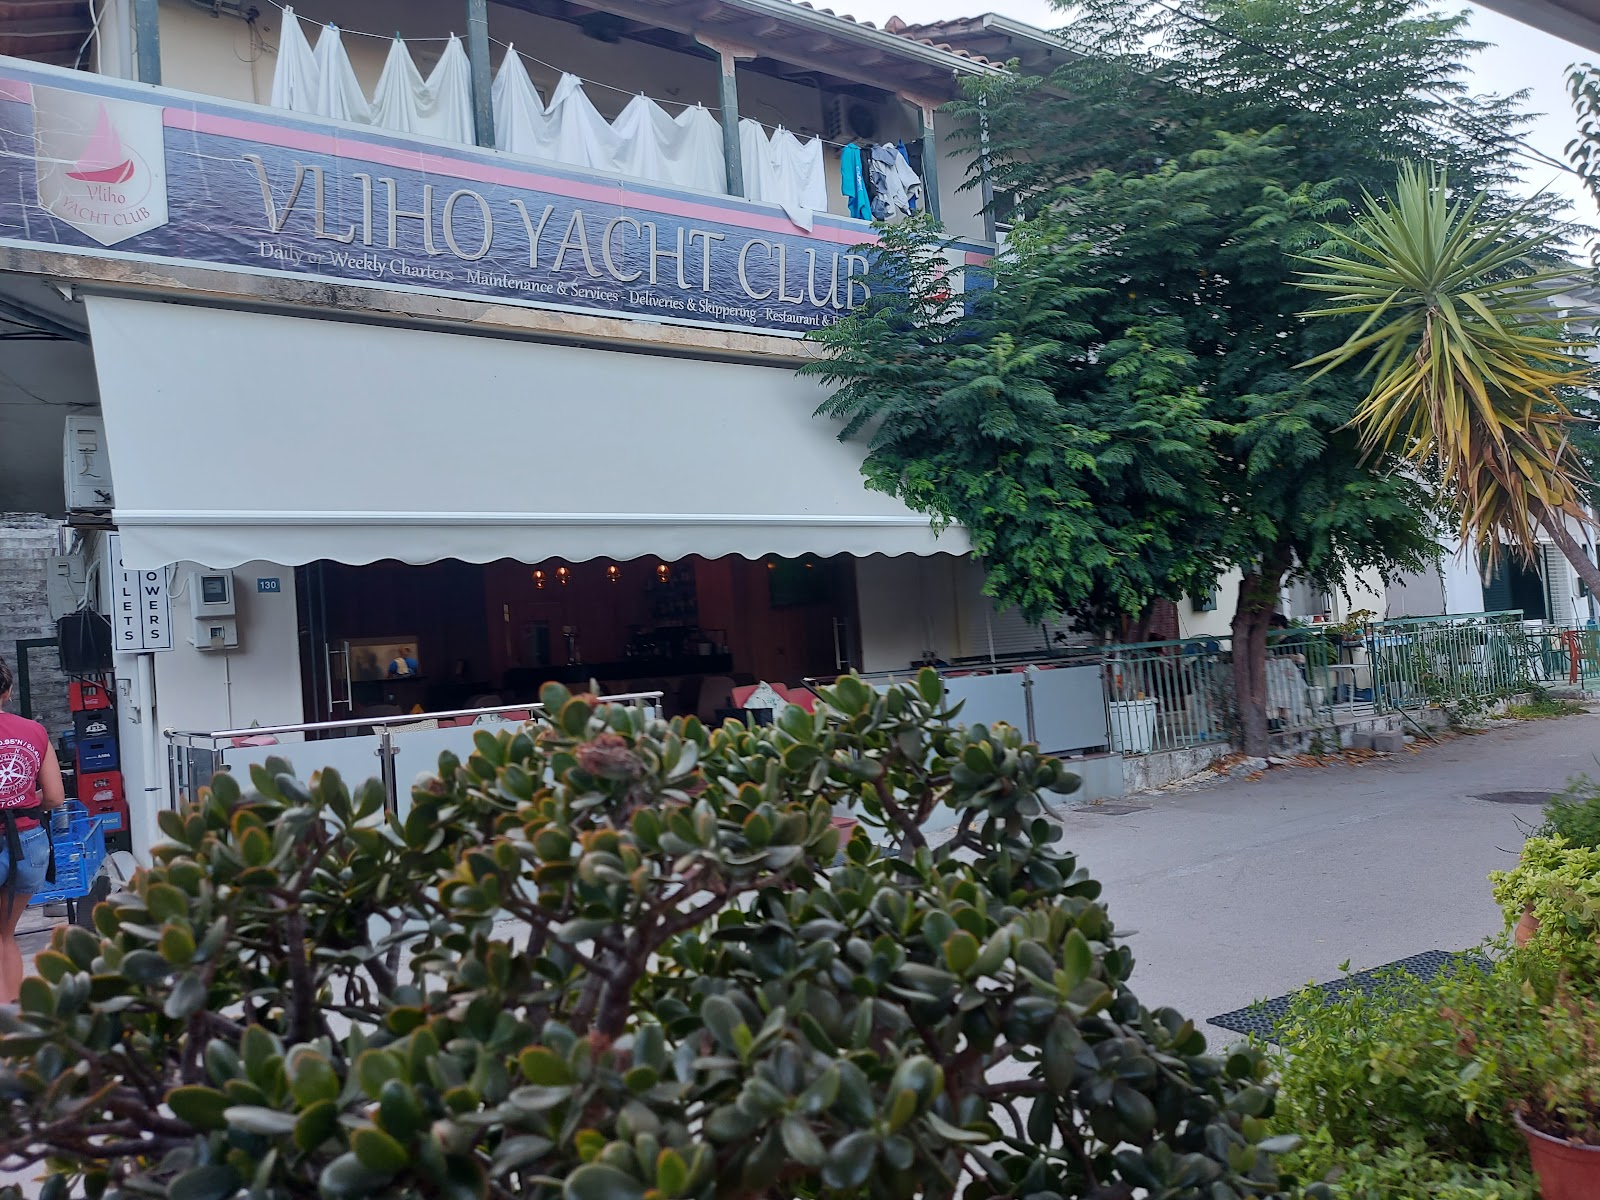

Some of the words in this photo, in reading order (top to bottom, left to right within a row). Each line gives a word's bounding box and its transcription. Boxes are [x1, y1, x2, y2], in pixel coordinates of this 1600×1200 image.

[63, 196, 110, 225] YACHT
[113, 207, 150, 226] CLUB
[86, 185, 126, 204] Vliho
[242, 154, 494, 261] VLIHO
[508, 199, 726, 292] YACHT
[737, 239, 871, 311] CLUB
[259, 241, 303, 266] Daily
[330, 251, 386, 278] Weekly
[389, 258, 454, 282] Charters
[467, 270, 554, 294] Maintenance
[556, 281, 569, 296] &
[570, 283, 619, 302] Services
[629, 290, 685, 309] Deliveries
[686, 298, 698, 312] &
[698, 299, 757, 323] Skippering
[765, 308, 820, 326] Restaurant
[821, 314, 831, 327] &
[119, 557, 134, 641] ILETS
[144, 571, 160, 640] OWERS
[259, 580, 277, 590] 130
[6, 795, 26, 807] CLUB
